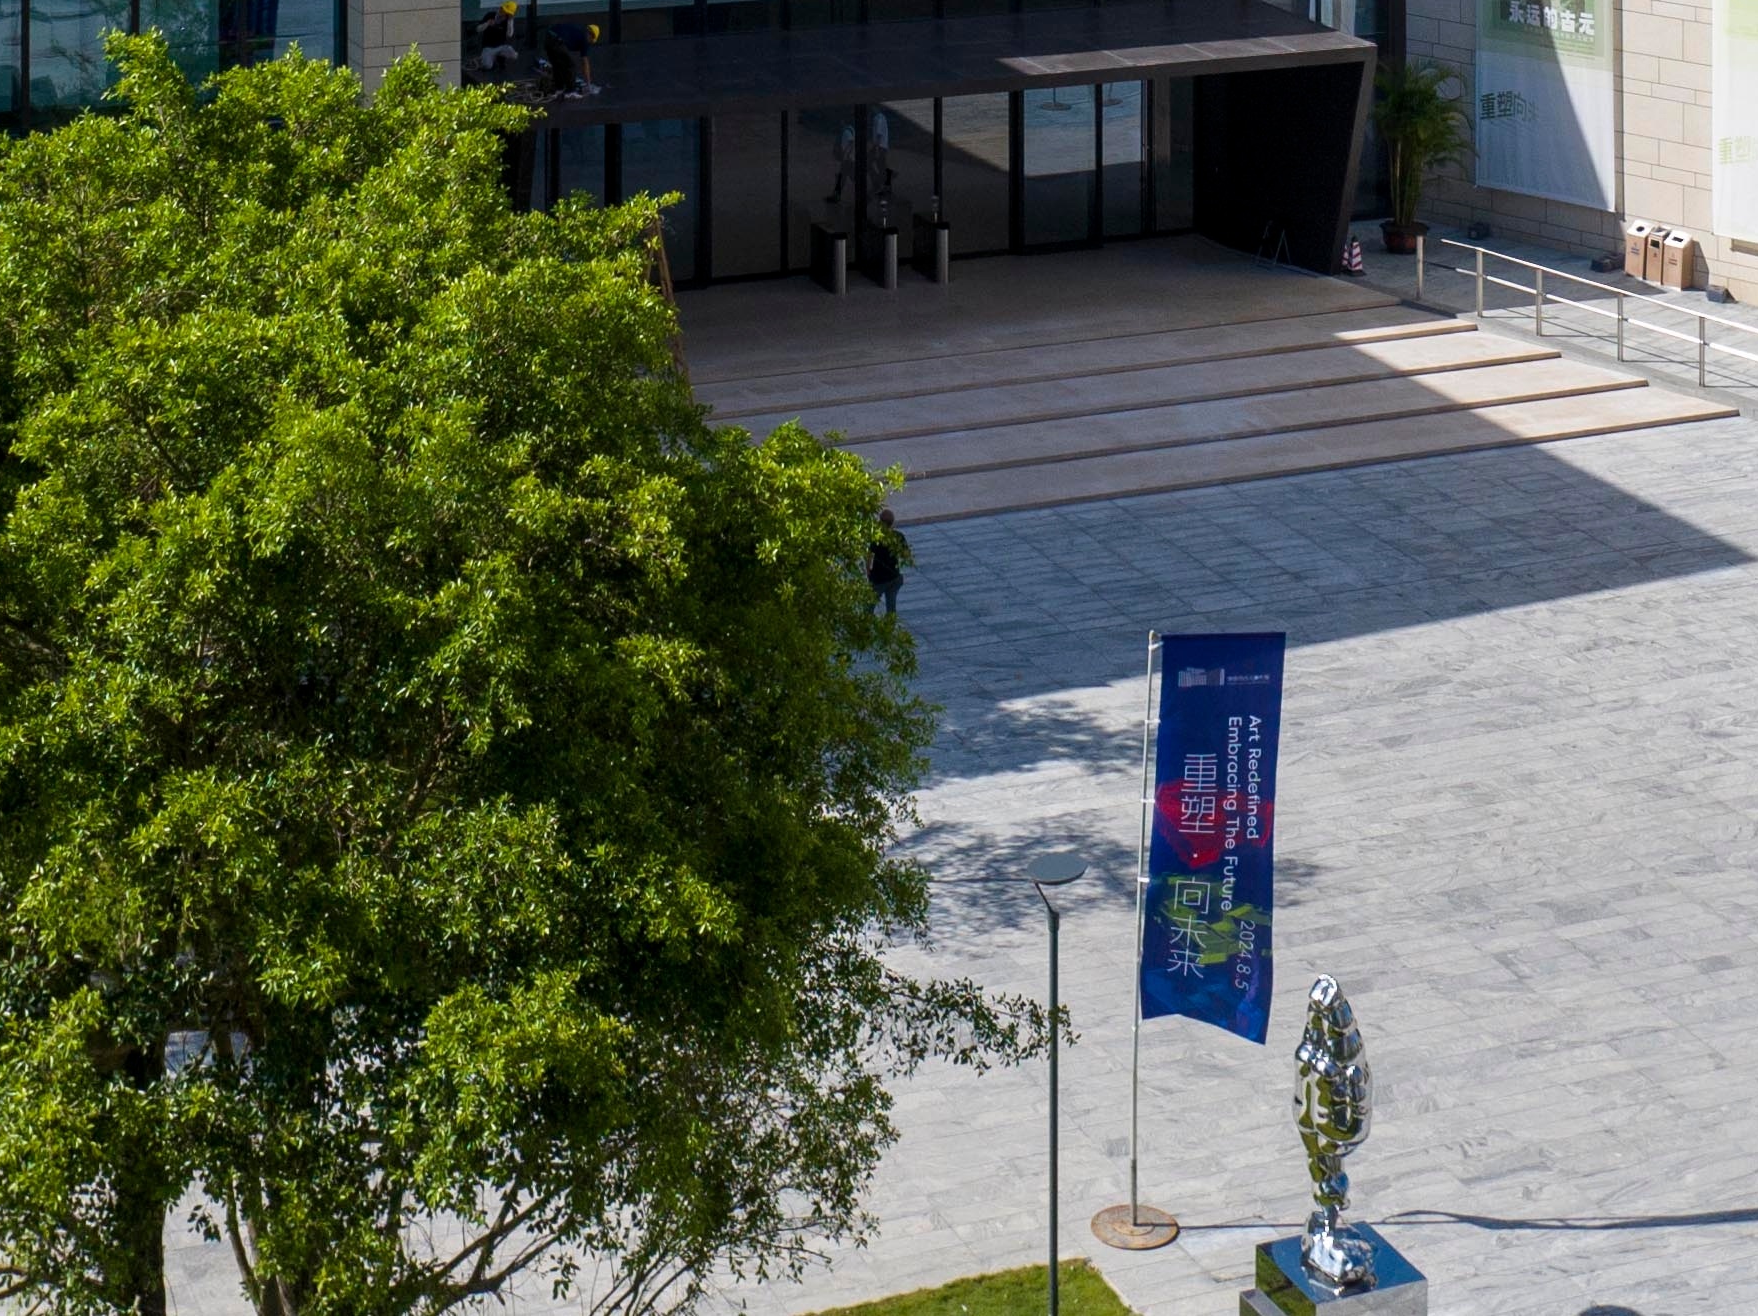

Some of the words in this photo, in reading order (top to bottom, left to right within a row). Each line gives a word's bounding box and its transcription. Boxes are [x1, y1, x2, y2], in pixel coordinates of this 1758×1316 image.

[1508, 0, 1595, 35] 永远的古元
[1248, 715, 1262, 742] Art
[1223, 716, 1242, 811] Embracing
[1246, 748, 1262, 839] Redefined
[1225, 818, 1240, 849] The
[1221, 856, 1238, 911] Future
[1234, 920, 1256, 991] 2024.8.5
